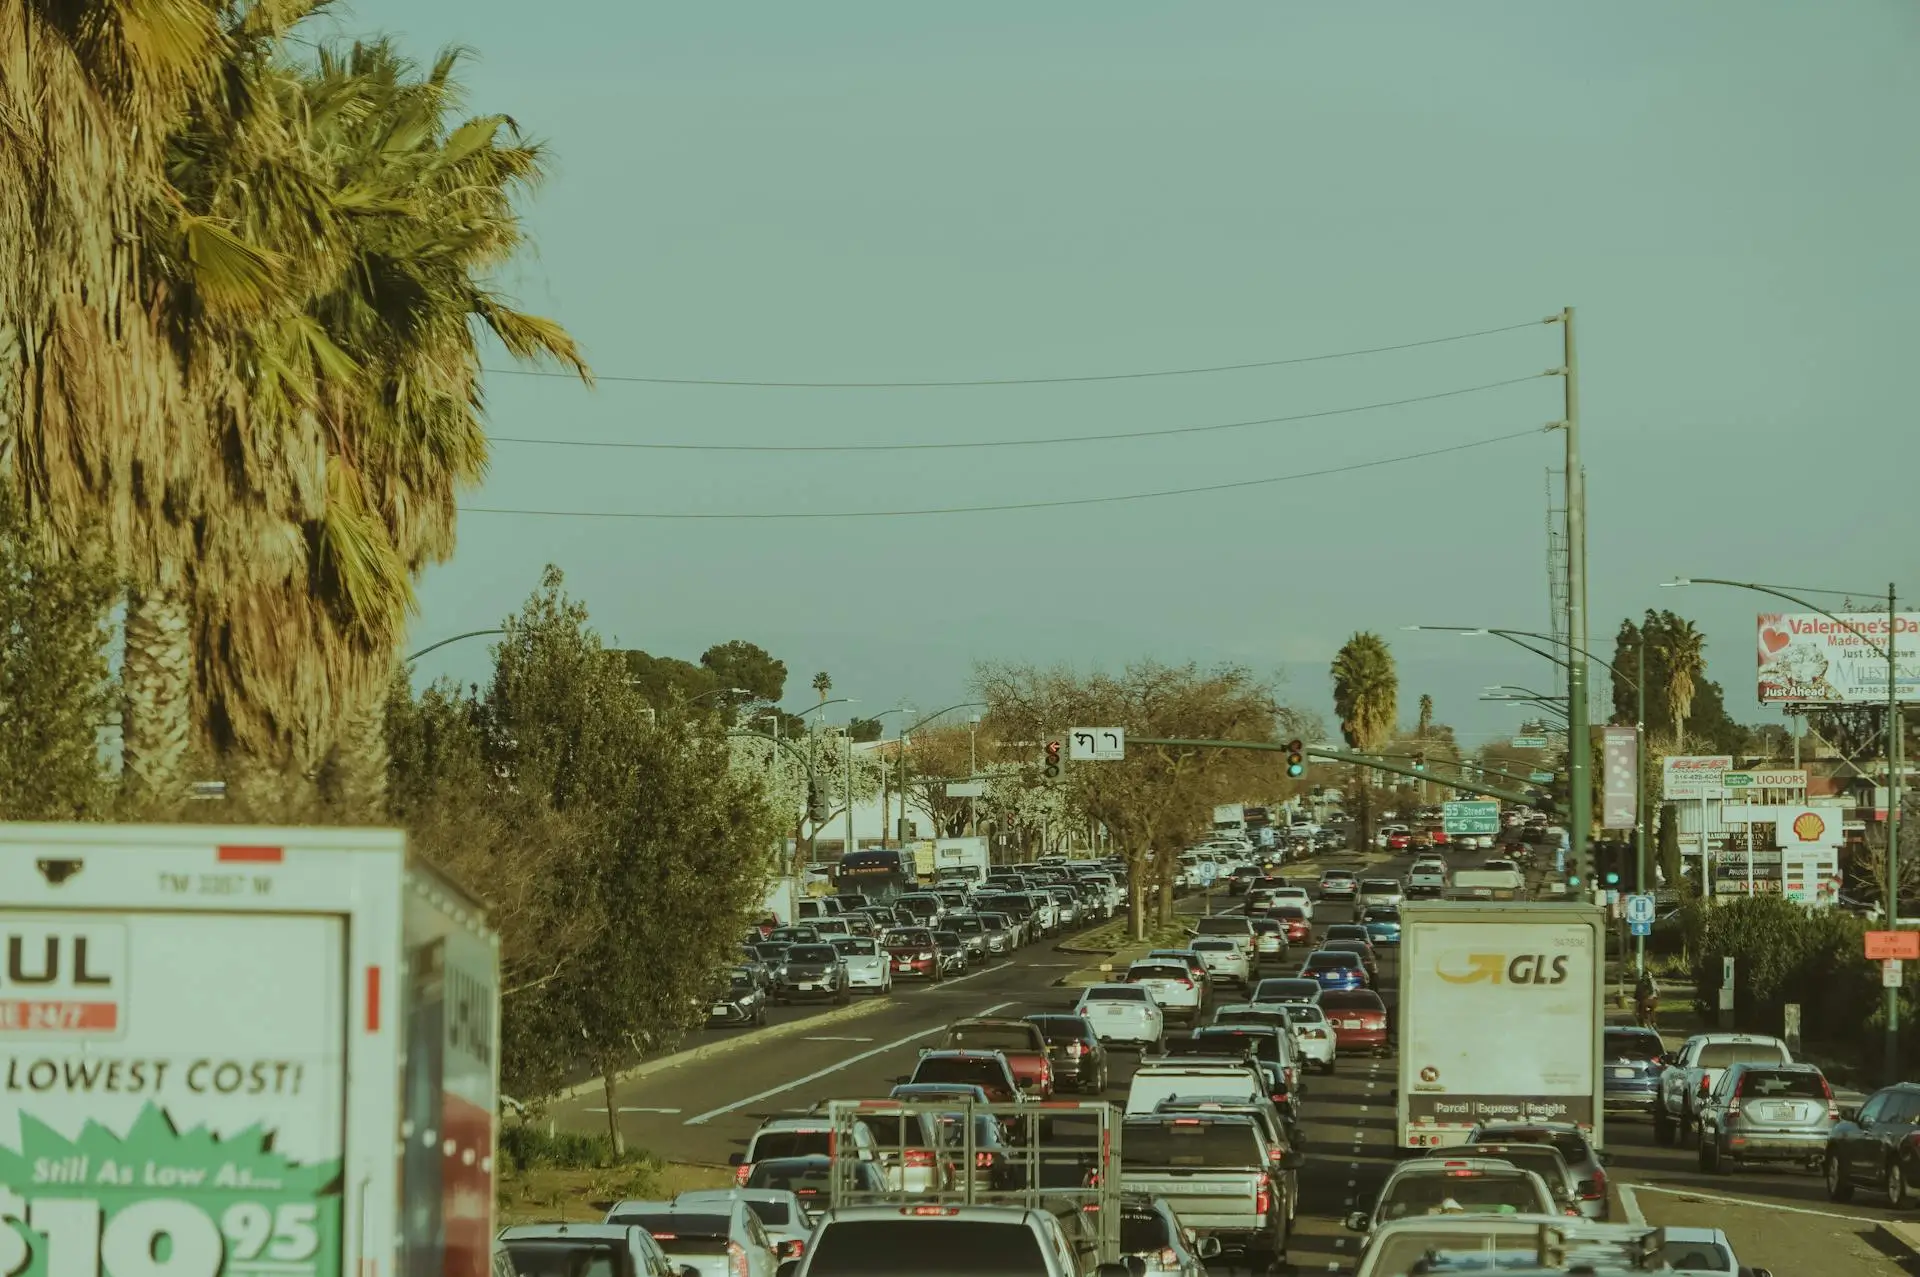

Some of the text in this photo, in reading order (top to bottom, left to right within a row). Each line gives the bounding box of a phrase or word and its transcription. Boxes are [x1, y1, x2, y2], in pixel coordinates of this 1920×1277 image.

[1893, 618, 1920, 633] Da
[1827, 635, 1859, 646] Made
[1764, 686, 1825, 697] Just Ahead
[1756, 775, 1806, 785] LIQUORS
[0, 934, 112, 986] UL
[1508, 955, 1569, 985] GLS
[7, 1059, 303, 1094] LOWEST COST!
[1435, 1102, 1567, 1118] Parcel Express Freight
[32, 1155, 88, 1184] Still
[97, 1158, 134, 1184] As
[144, 1161, 207, 1186] Low
